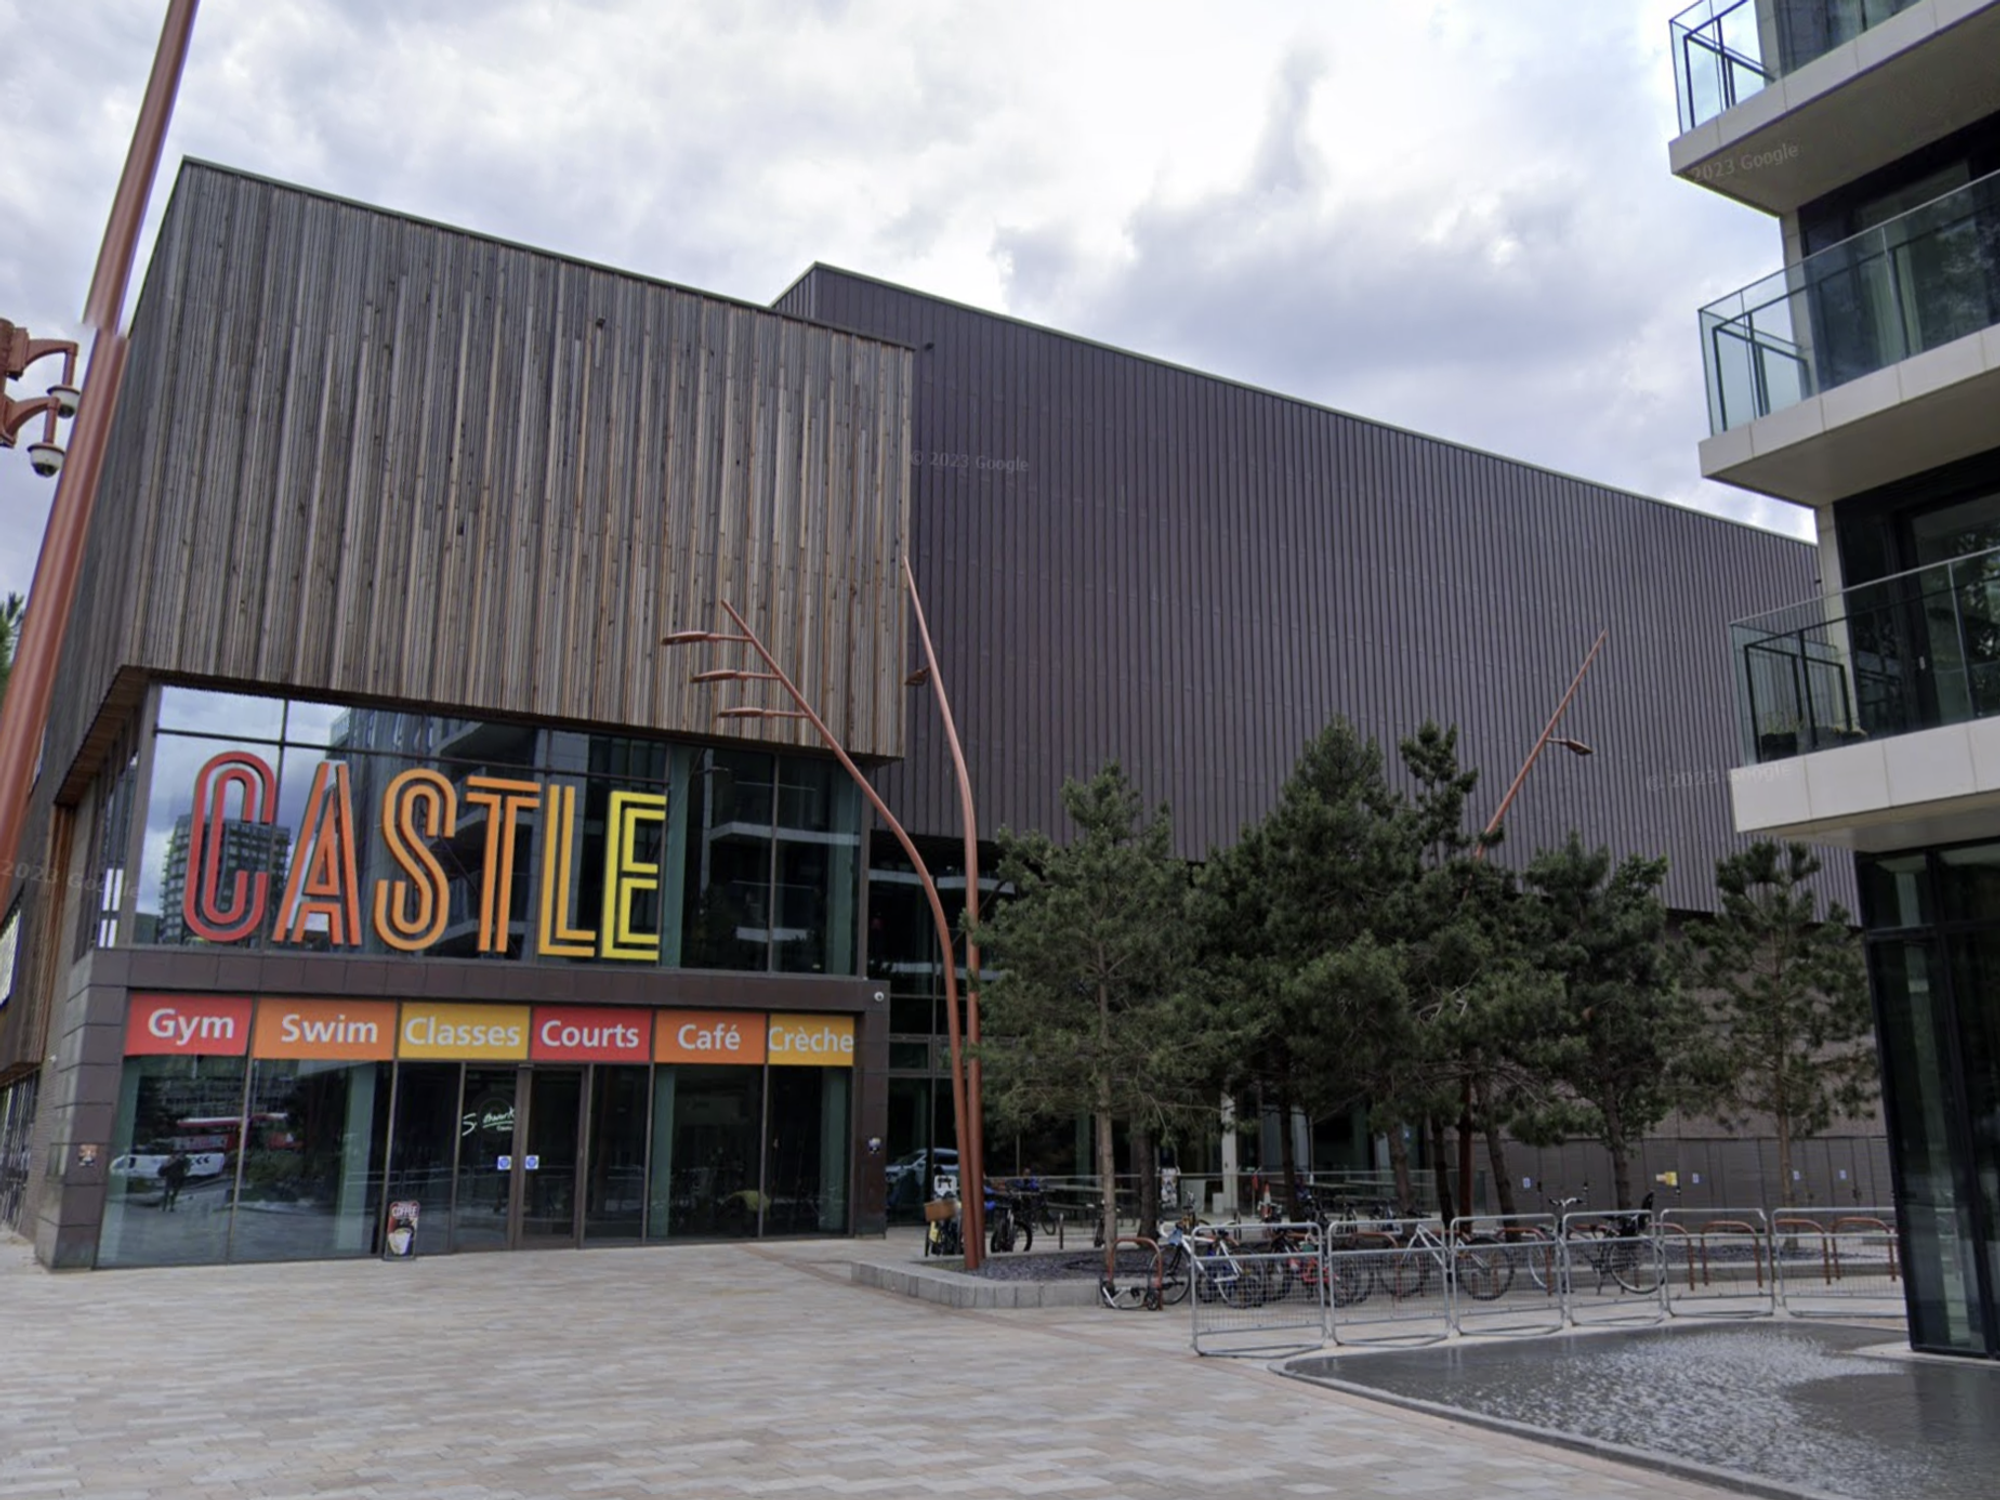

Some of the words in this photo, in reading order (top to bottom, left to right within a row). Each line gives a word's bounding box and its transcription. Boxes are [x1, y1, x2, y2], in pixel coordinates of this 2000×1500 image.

[182, 750, 668, 961] CASTLE
[147, 1008, 235, 1045] Gym
[280, 1013, 379, 1044] Swim
[404, 1016, 521, 1047] Classes
[540, 1019, 640, 1048] Courts
[677, 1023, 741, 1051] Café
[768, 1026, 854, 1053] Crèche
